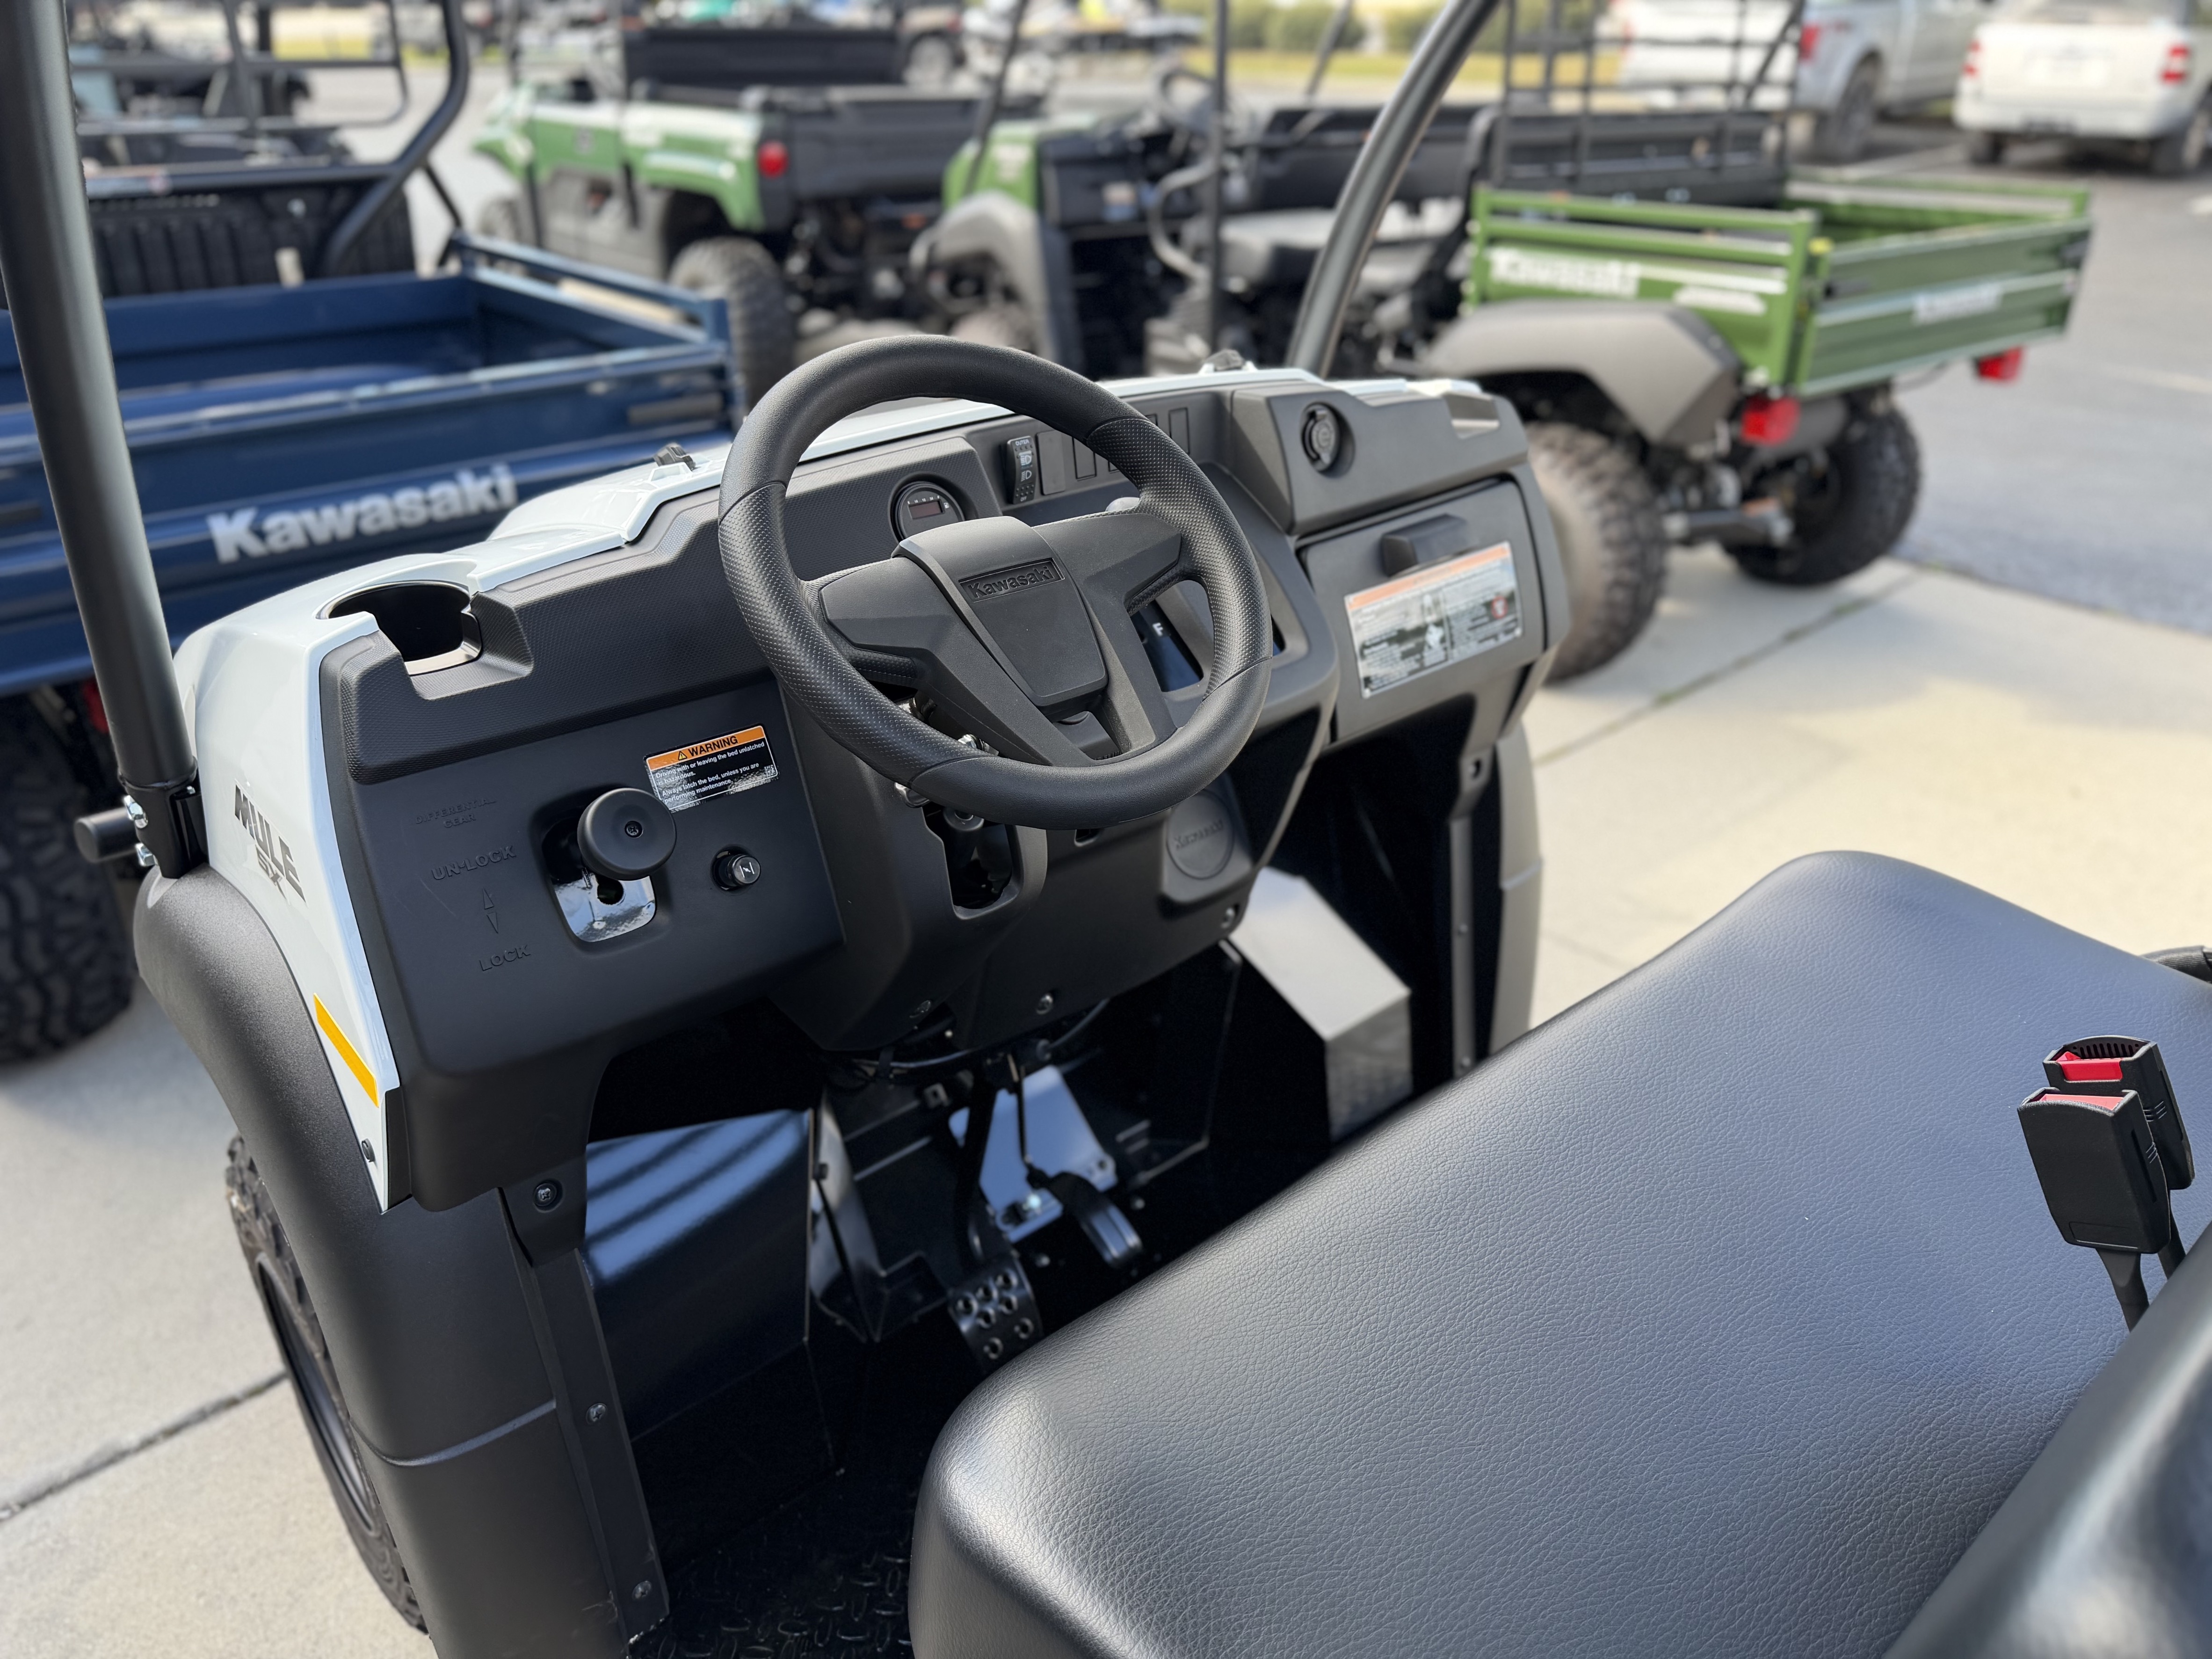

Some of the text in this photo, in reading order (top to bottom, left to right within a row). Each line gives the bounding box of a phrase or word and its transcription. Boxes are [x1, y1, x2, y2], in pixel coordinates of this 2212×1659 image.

[206, 463, 518, 563] Kawasaki
[967, 566, 1055, 599] Kawasaki
[1152, 622, 1163, 636] F
[688, 735, 738, 757] WARNING
[655, 768, 676, 779] Driving
[696, 757, 717, 766] leaving
[739, 742, 765, 754] unlatched
[662, 786, 682, 797] Always
[682, 781, 697, 790] latch
[721, 769, 739, 778] unless
[665, 771, 696, 784] hazardous.
[665, 779, 733, 804] performing maintenance.
[443, 813, 476, 828] GEAR
[235, 784, 306, 903] MULE
[255, 844, 287, 899] SX
[431, 845, 516, 880] UN-LOCK
[479, 944, 531, 972] LOCK
